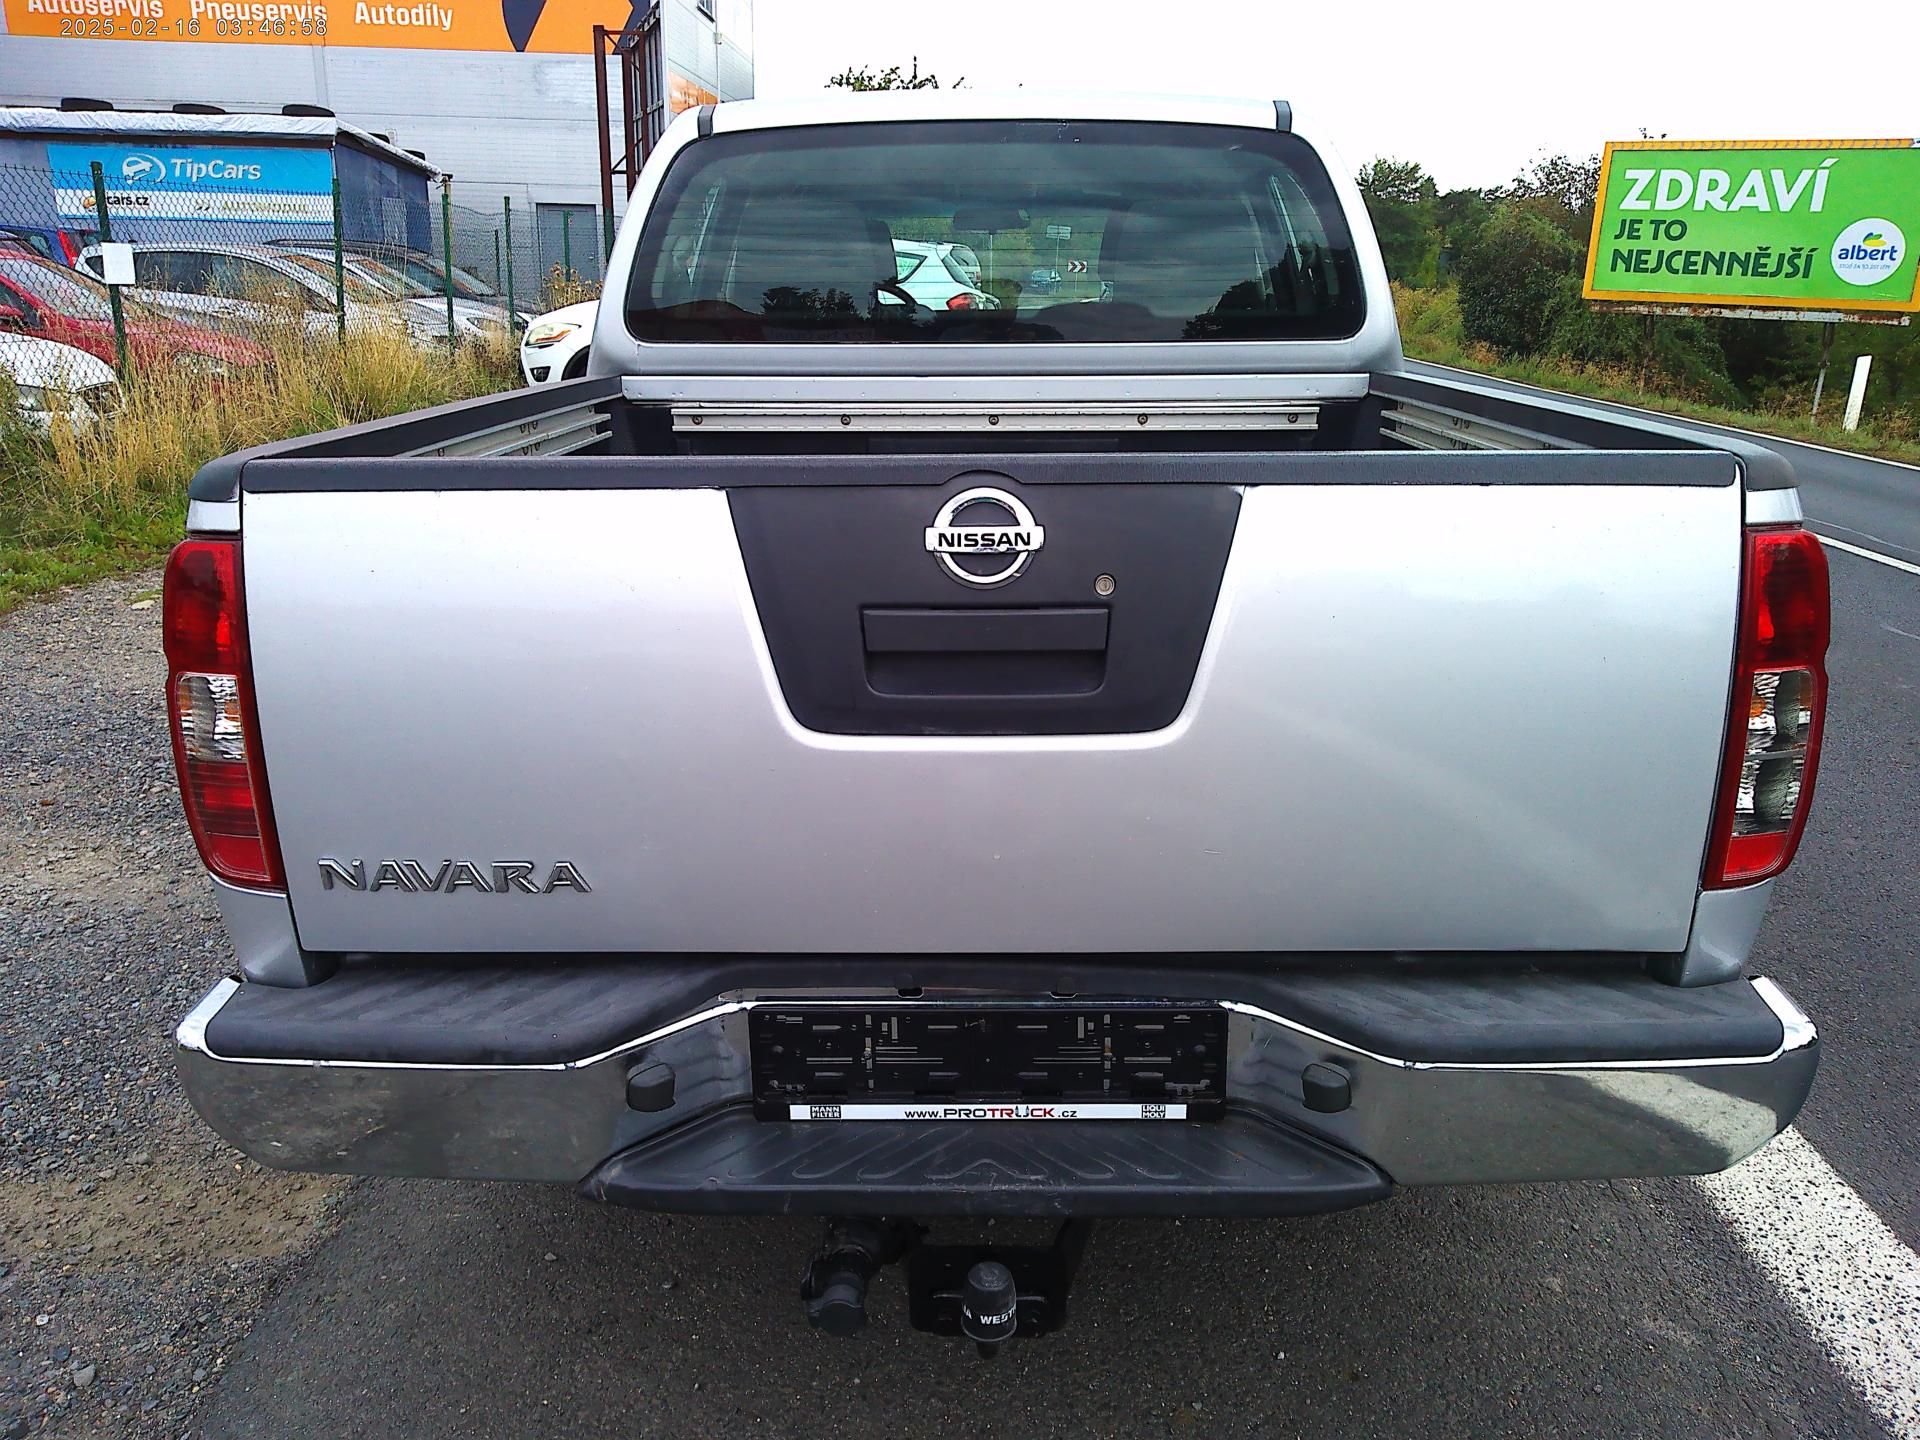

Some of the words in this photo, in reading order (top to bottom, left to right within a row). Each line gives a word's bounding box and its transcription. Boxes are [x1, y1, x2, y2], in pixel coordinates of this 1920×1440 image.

[29, 0, 164, 18] Autoservis
[190, 0, 327, 22] Pneuservis
[355, 1, 453, 31] Autodíly
[171, 158, 261, 180] TipCars
[1620, 158, 1839, 212] ZDRAVÍ
[1614, 218, 1643, 240] JE
[1649, 219, 1687, 241] TO
[1610, 247, 1818, 278] NEJCENNĚJŠÍ
[1838, 244, 1898, 261] albert
[938, 532, 1031, 548] NISSAN
[318, 858, 592, 893] NAVARA
